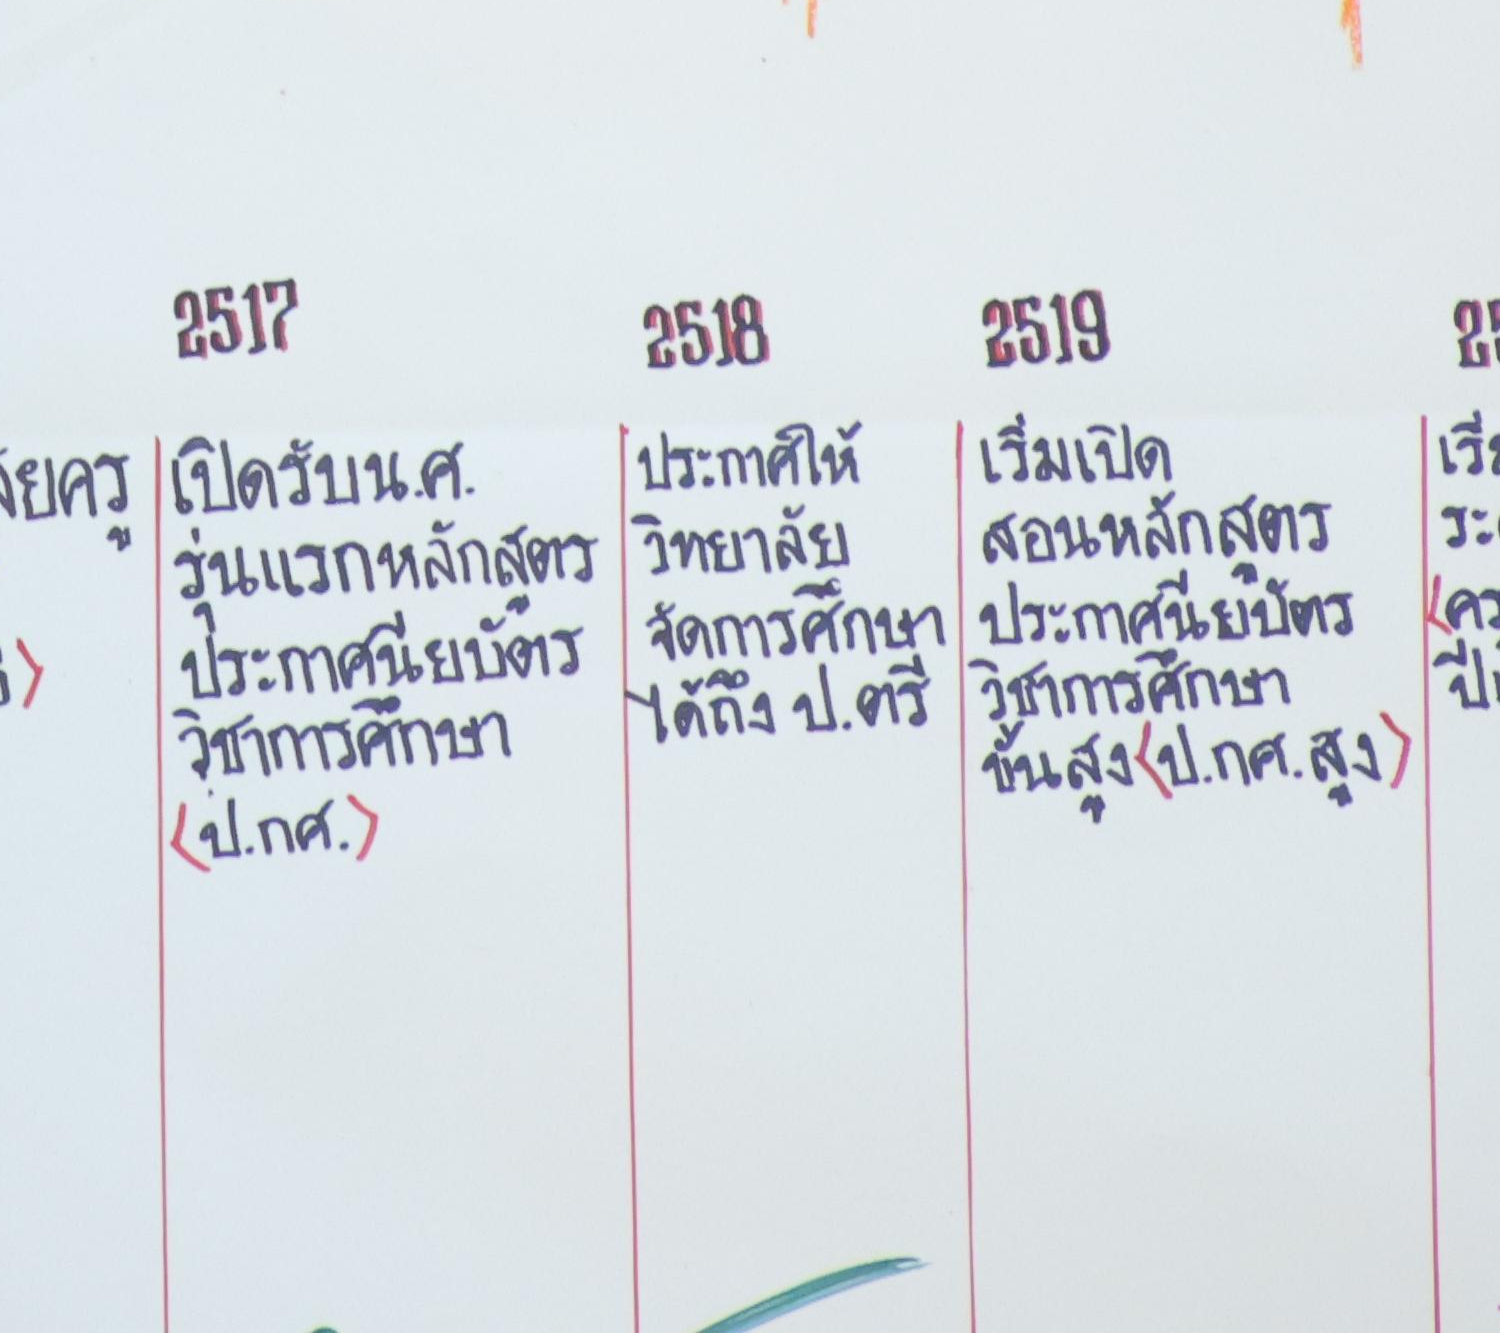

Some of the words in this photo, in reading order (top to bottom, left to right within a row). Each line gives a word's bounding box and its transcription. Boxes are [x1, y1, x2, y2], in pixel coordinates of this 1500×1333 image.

[173, 278, 298, 360] 2517
[643, 294, 771, 369] 2518
[981, 288, 1112, 368] 2519
[638, 421, 862, 490] ประกาศให้
[980, 412, 1173, 484] เริ่มเปิด
[173, 520, 598, 632] รุ่นแรกหลักสูตร
[630, 503, 850, 575] วิทยาลัย
[982, 491, 1332, 585] สอนหลักสูตร
[646, 577, 945, 661] จัดการศึกษา
[979, 570, 1354, 646] ประกาศนียบัตร
[181, 610, 584, 700] ประกาศนียบัตร
[968, 648, 1291, 721] วิชาการศึกษา
[172, 695, 511, 781] วิชาการศึกษา
[625, 668, 776, 743] ได้ถึง
[792, 653, 931, 732] ป.ตรี
